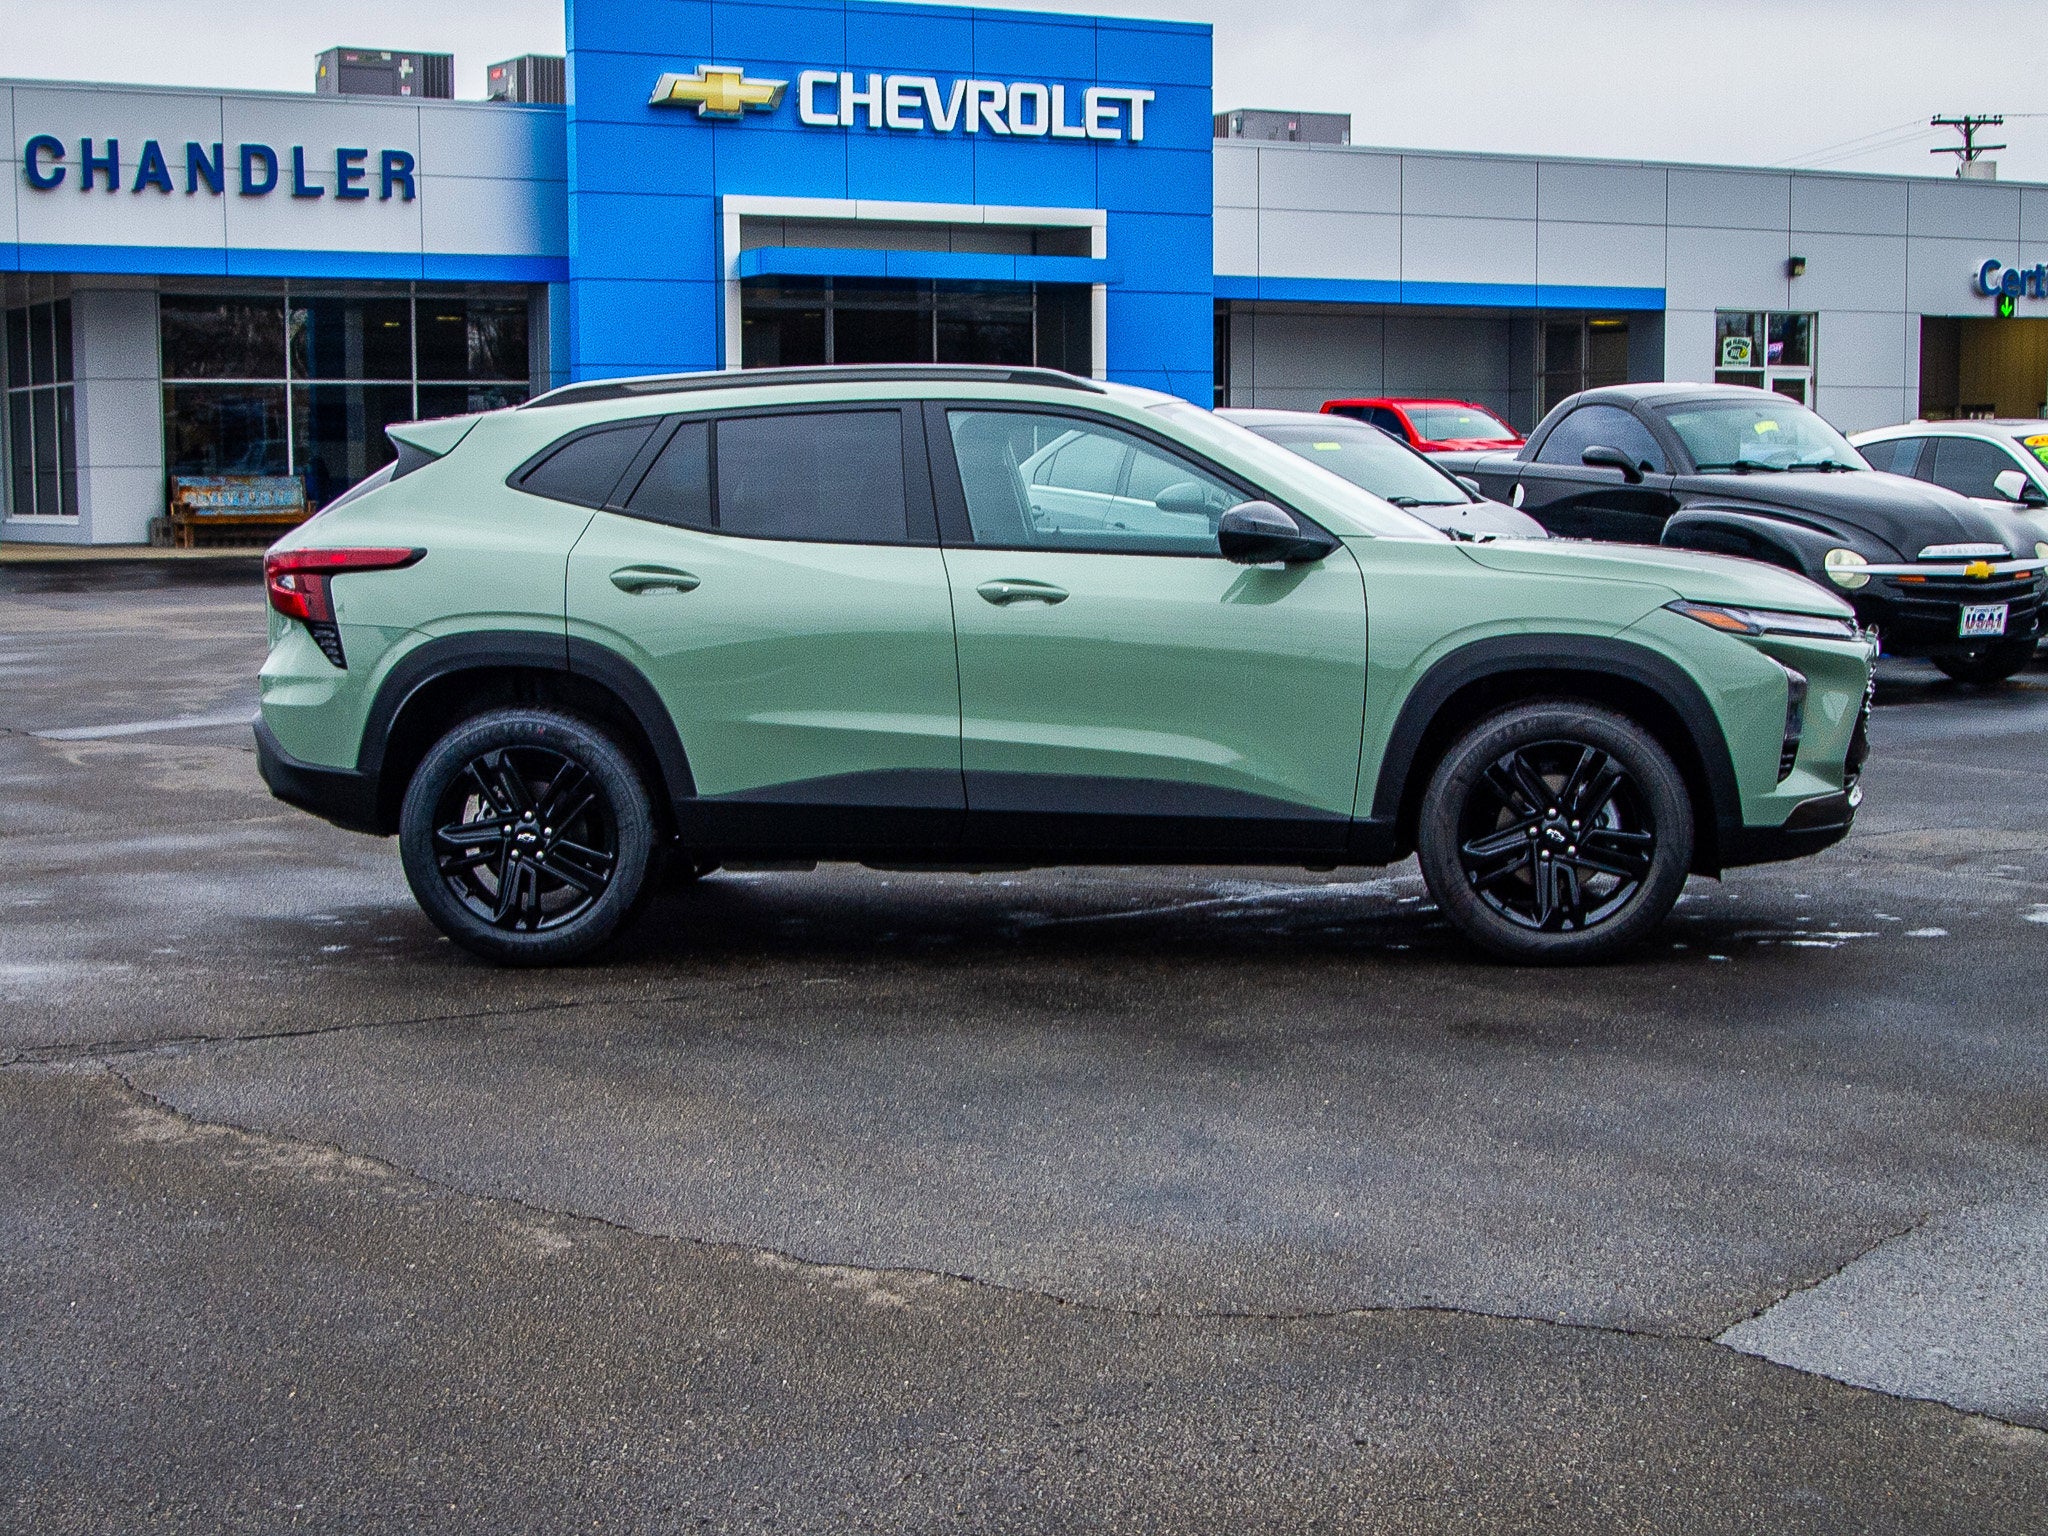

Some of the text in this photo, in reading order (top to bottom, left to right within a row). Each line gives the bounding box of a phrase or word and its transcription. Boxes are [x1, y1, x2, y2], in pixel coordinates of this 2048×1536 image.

[798, 69, 1155, 142] CHEVROLET
[24, 133, 417, 200] CHANDLER
[1964, 612, 2003, 630] USA1
